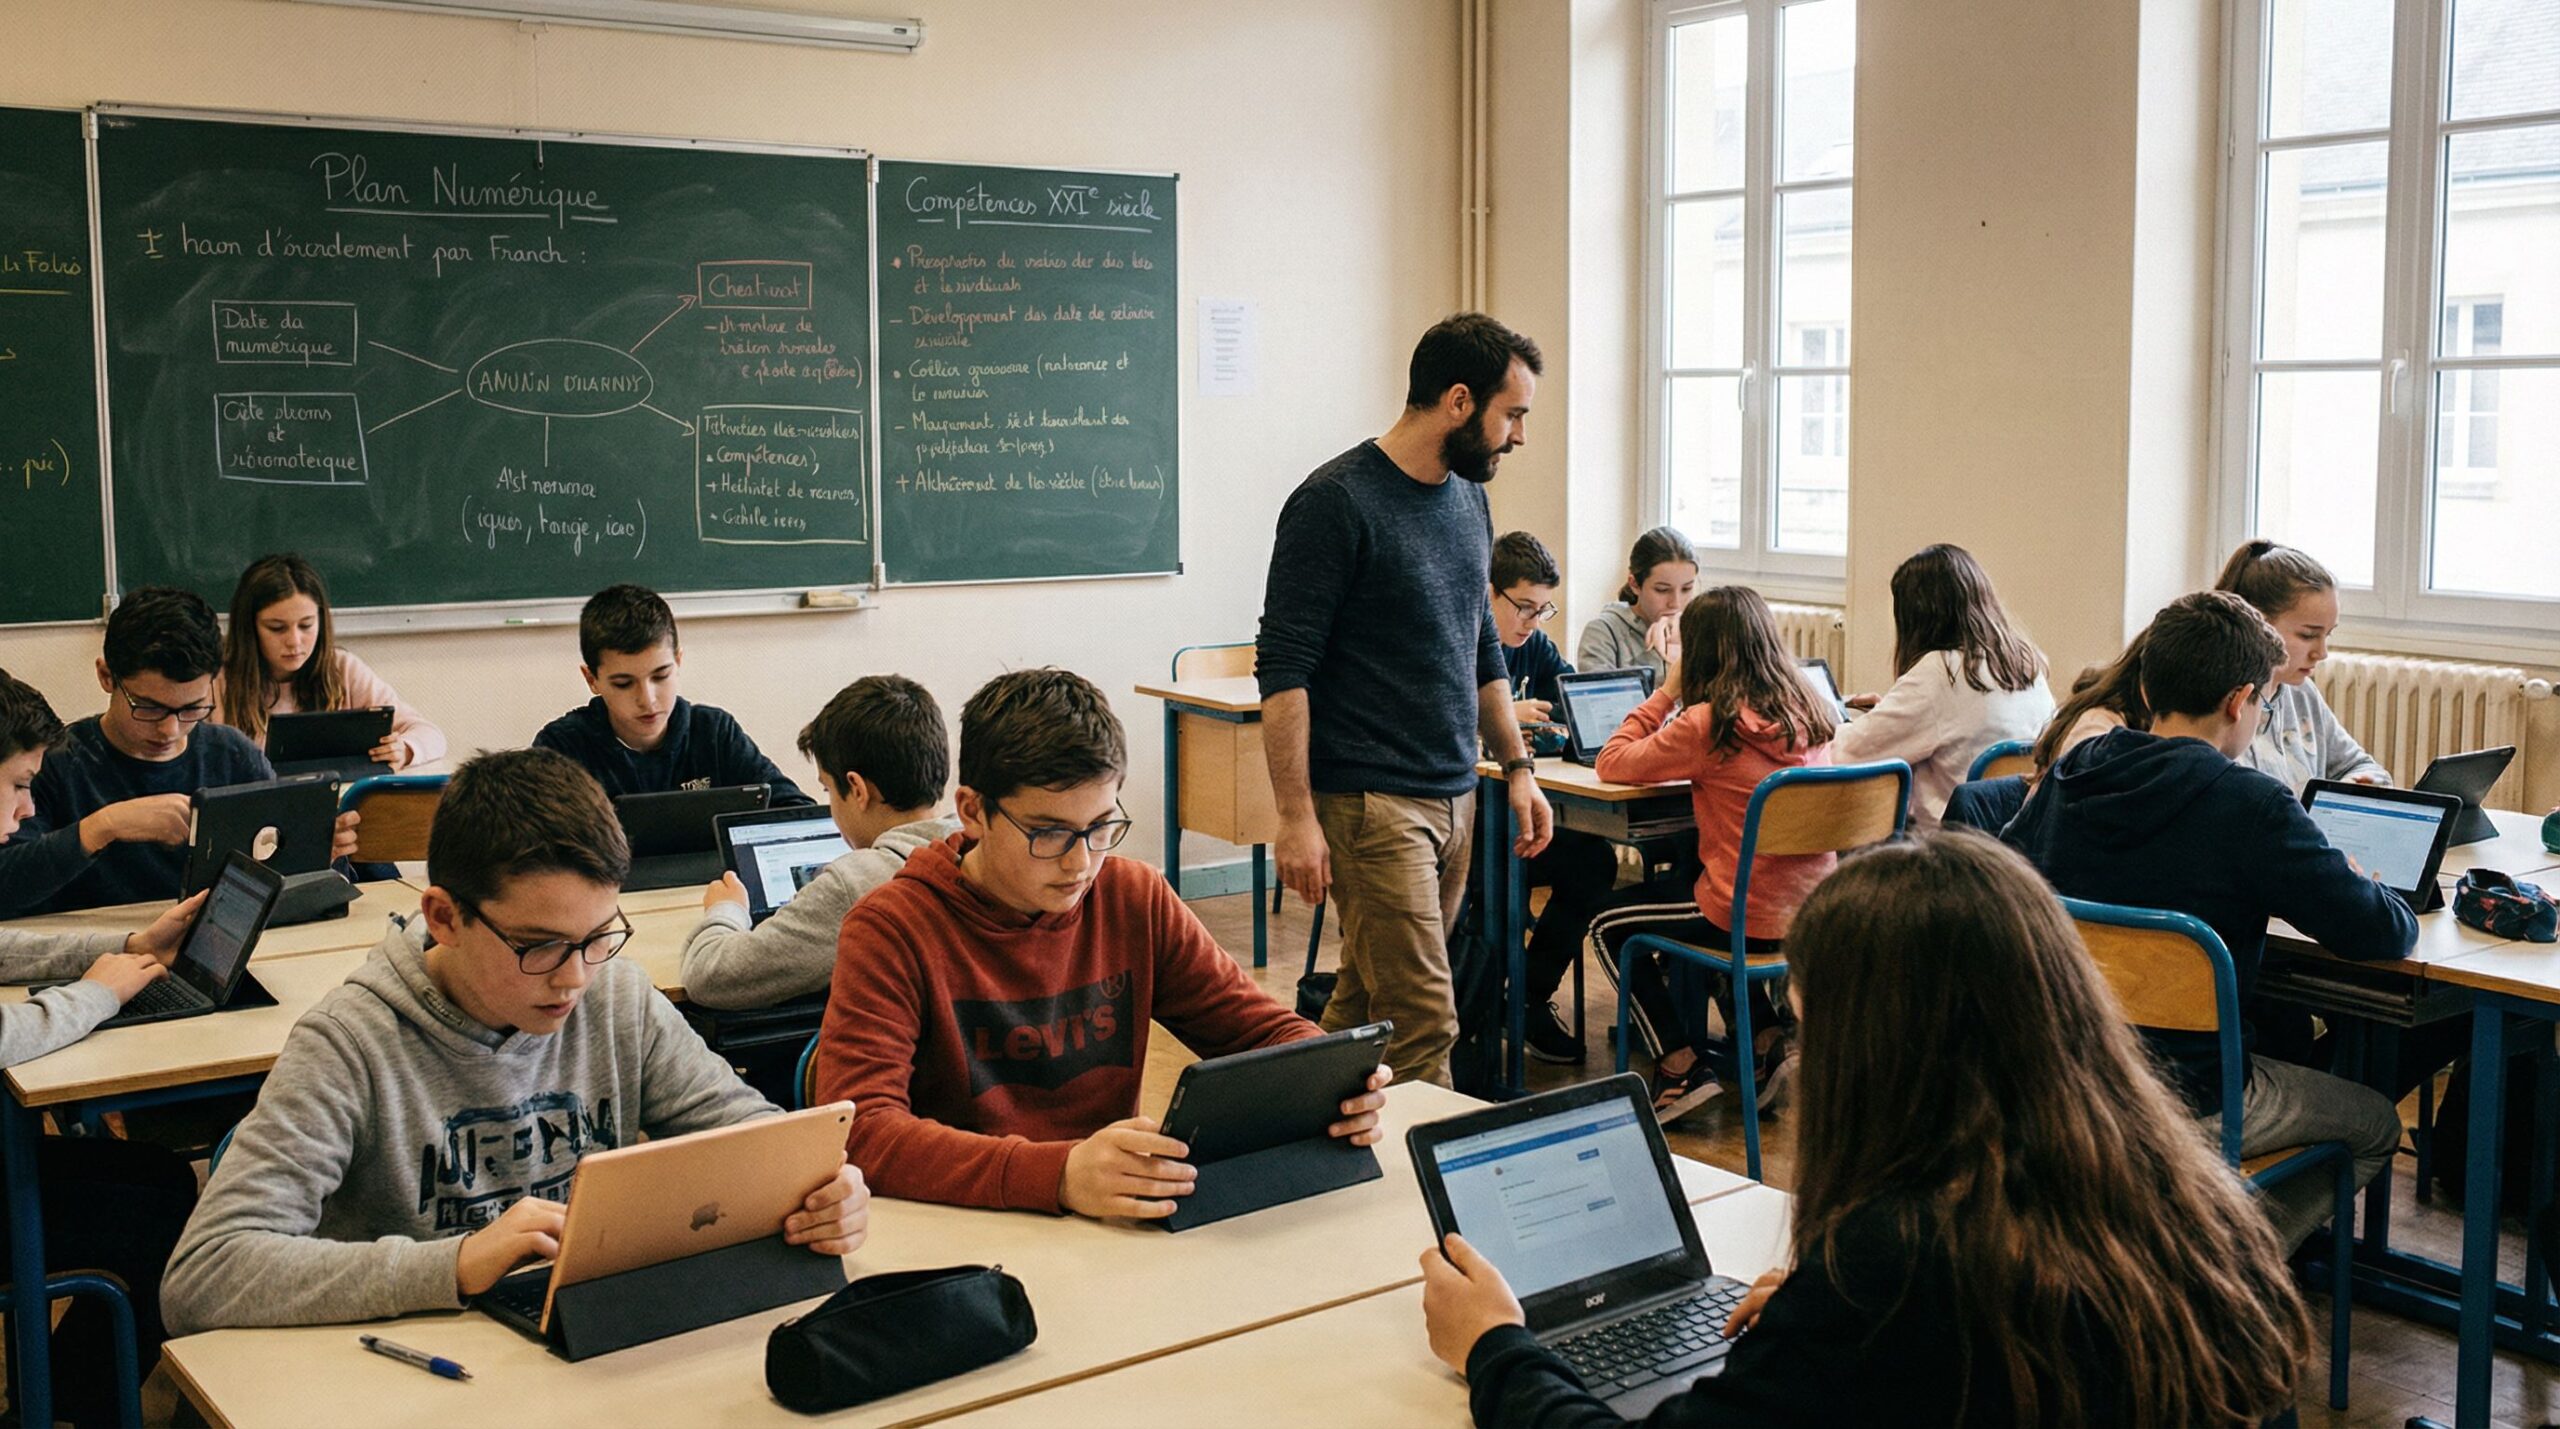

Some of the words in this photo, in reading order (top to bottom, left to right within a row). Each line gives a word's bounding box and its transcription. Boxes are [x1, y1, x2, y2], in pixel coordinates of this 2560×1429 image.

[310, 152, 410, 203] Plan
[433, 163, 610, 229] Numérique
[906, 176, 1038, 229] Compétences
[1105, 189, 1162, 220] siècle
[432, 246, 473, 278] par
[489, 235, 568, 264] Franch
[908, 301, 1016, 334] Développement
[226, 333, 338, 368] numérique
[1116, 350, 1129, 370] et
